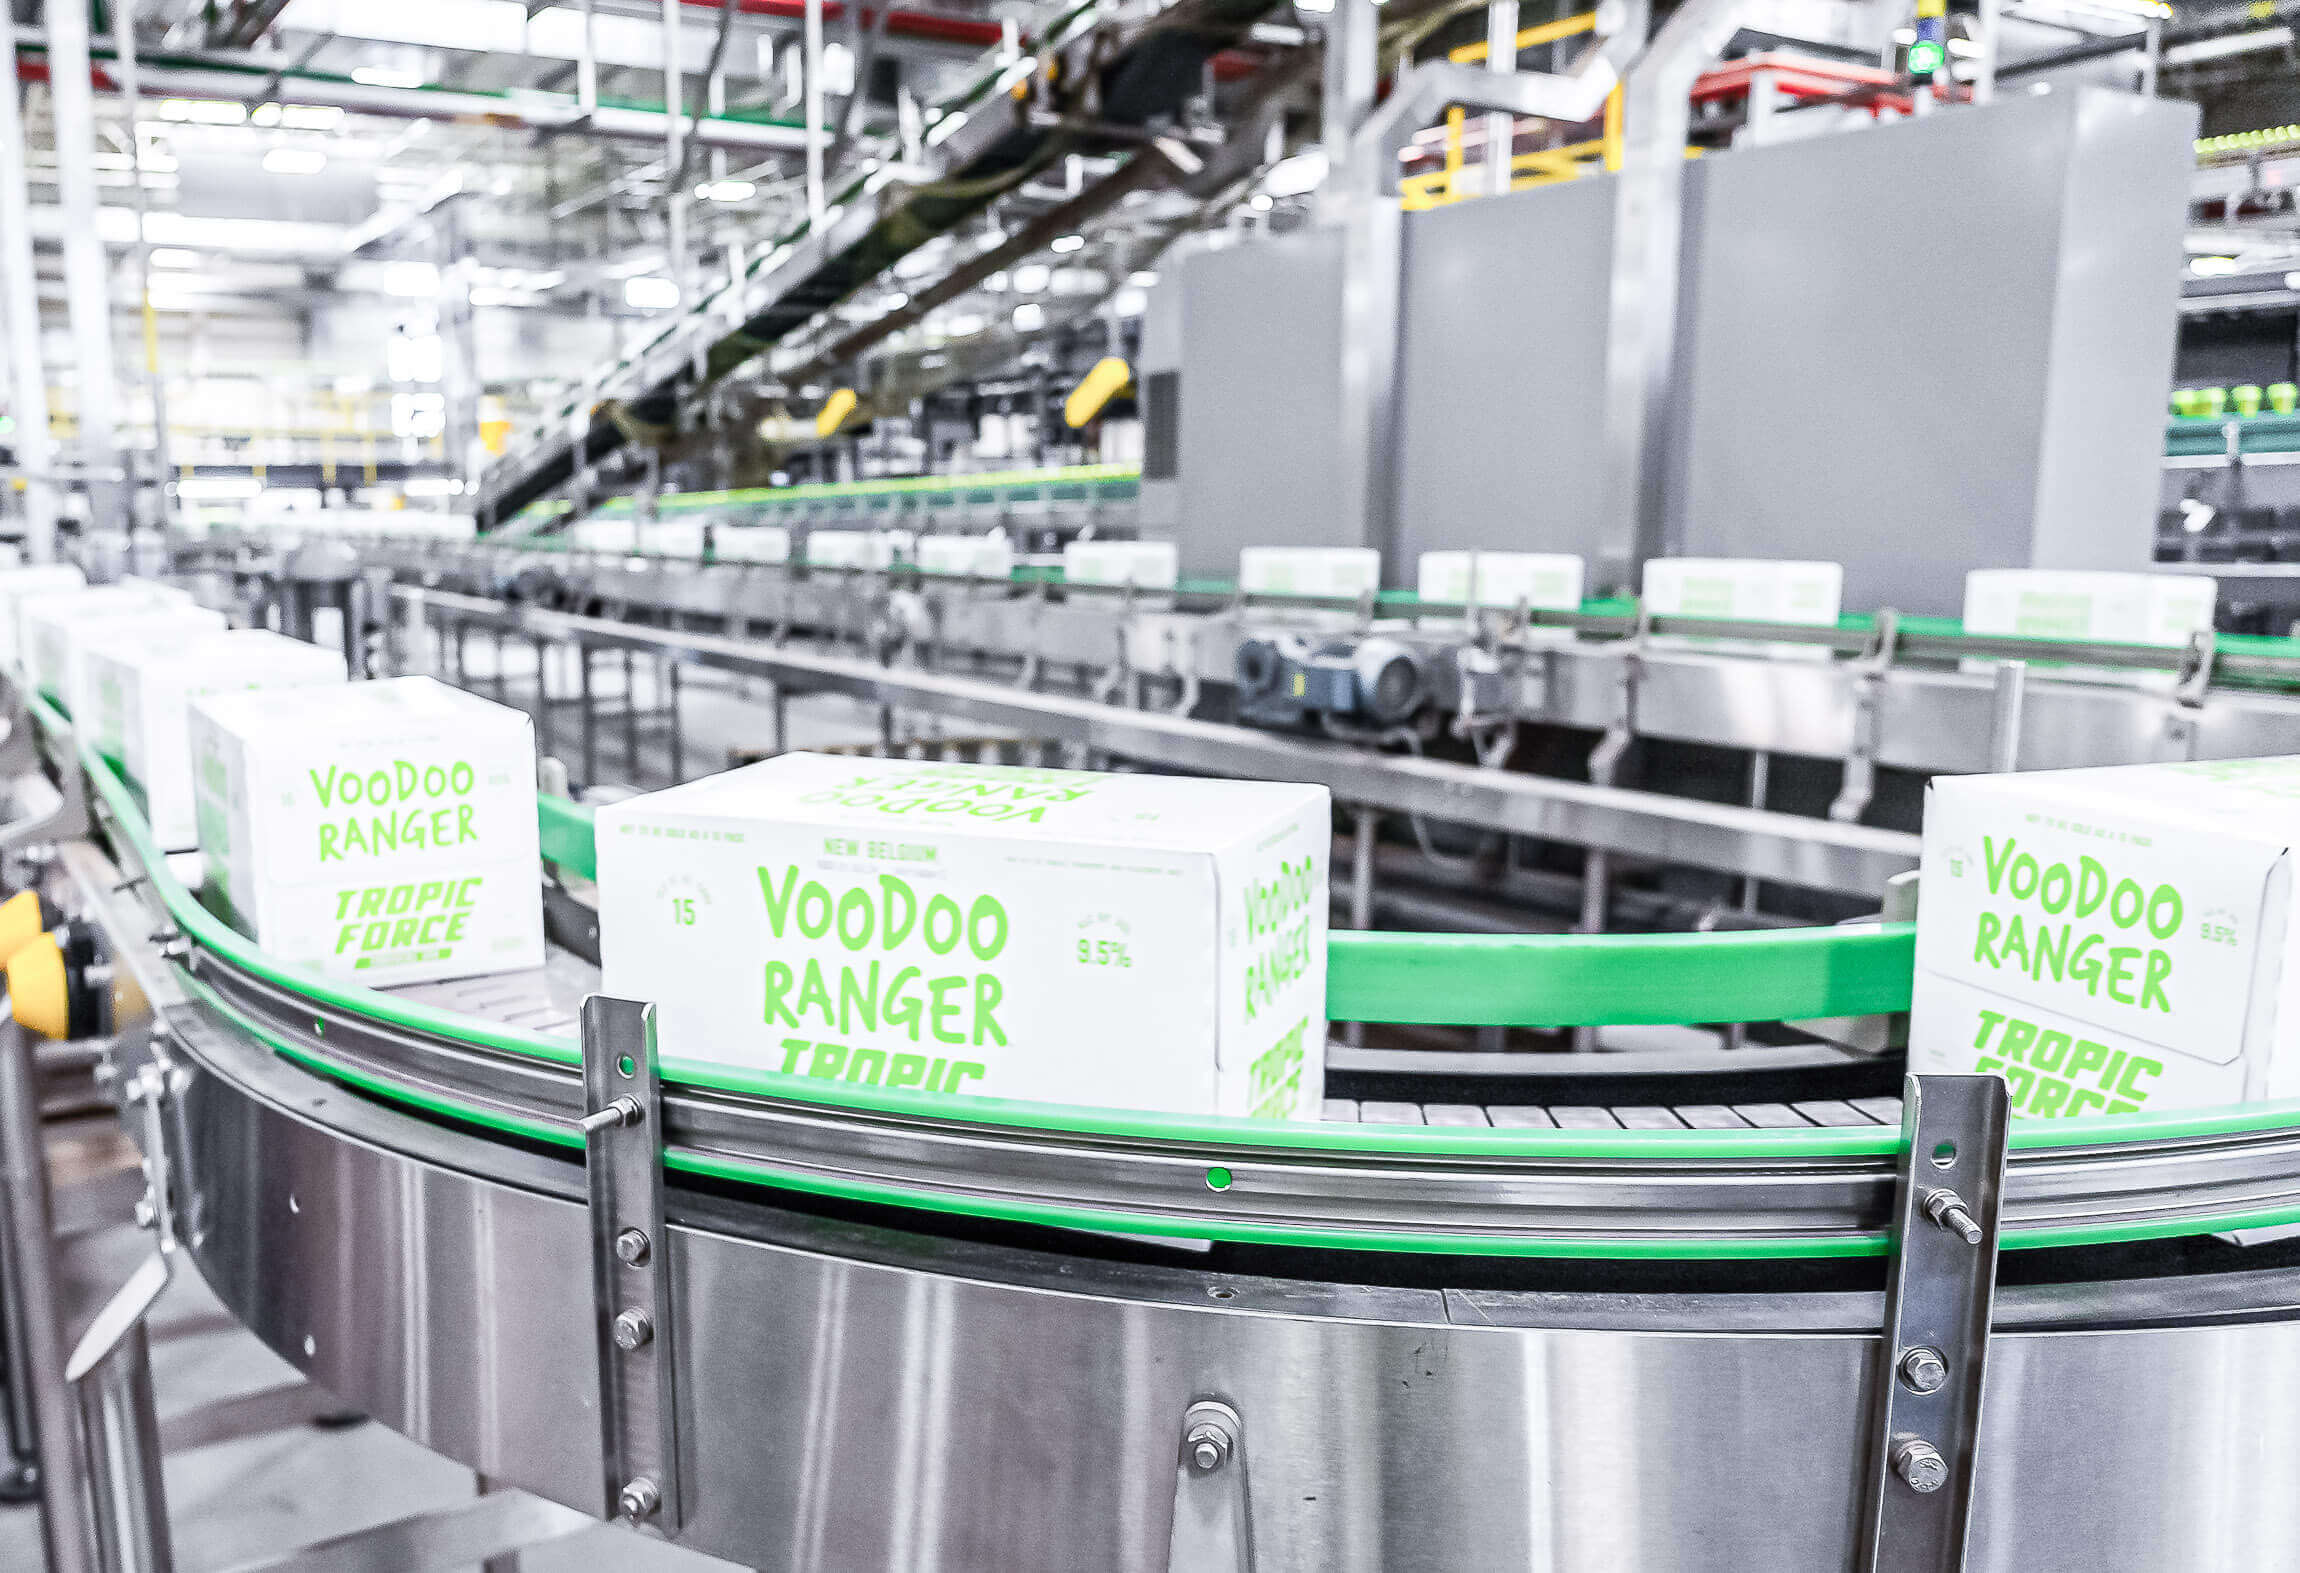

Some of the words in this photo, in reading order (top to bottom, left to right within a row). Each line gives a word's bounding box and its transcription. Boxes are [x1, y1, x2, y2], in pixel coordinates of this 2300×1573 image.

[308, 759, 477, 810] VOODOO
[317, 803, 479, 863] RANGER
[823, 837, 860, 857] NEW
[335, 876, 484, 921] TROPIC
[672, 898, 697, 926] 15
[756, 864, 1009, 962] VOODOO
[1981, 834, 2185, 940] VOODOO
[334, 911, 474, 956] FORCE
[1077, 938, 1133, 969] 9.5%
[1973, 911, 2173, 1014] RANGER
[763, 957, 1009, 1048] RANGER
[778, 1038, 986, 1094] TROPIC
[1973, 1009, 2164, 1104] TROPIC
